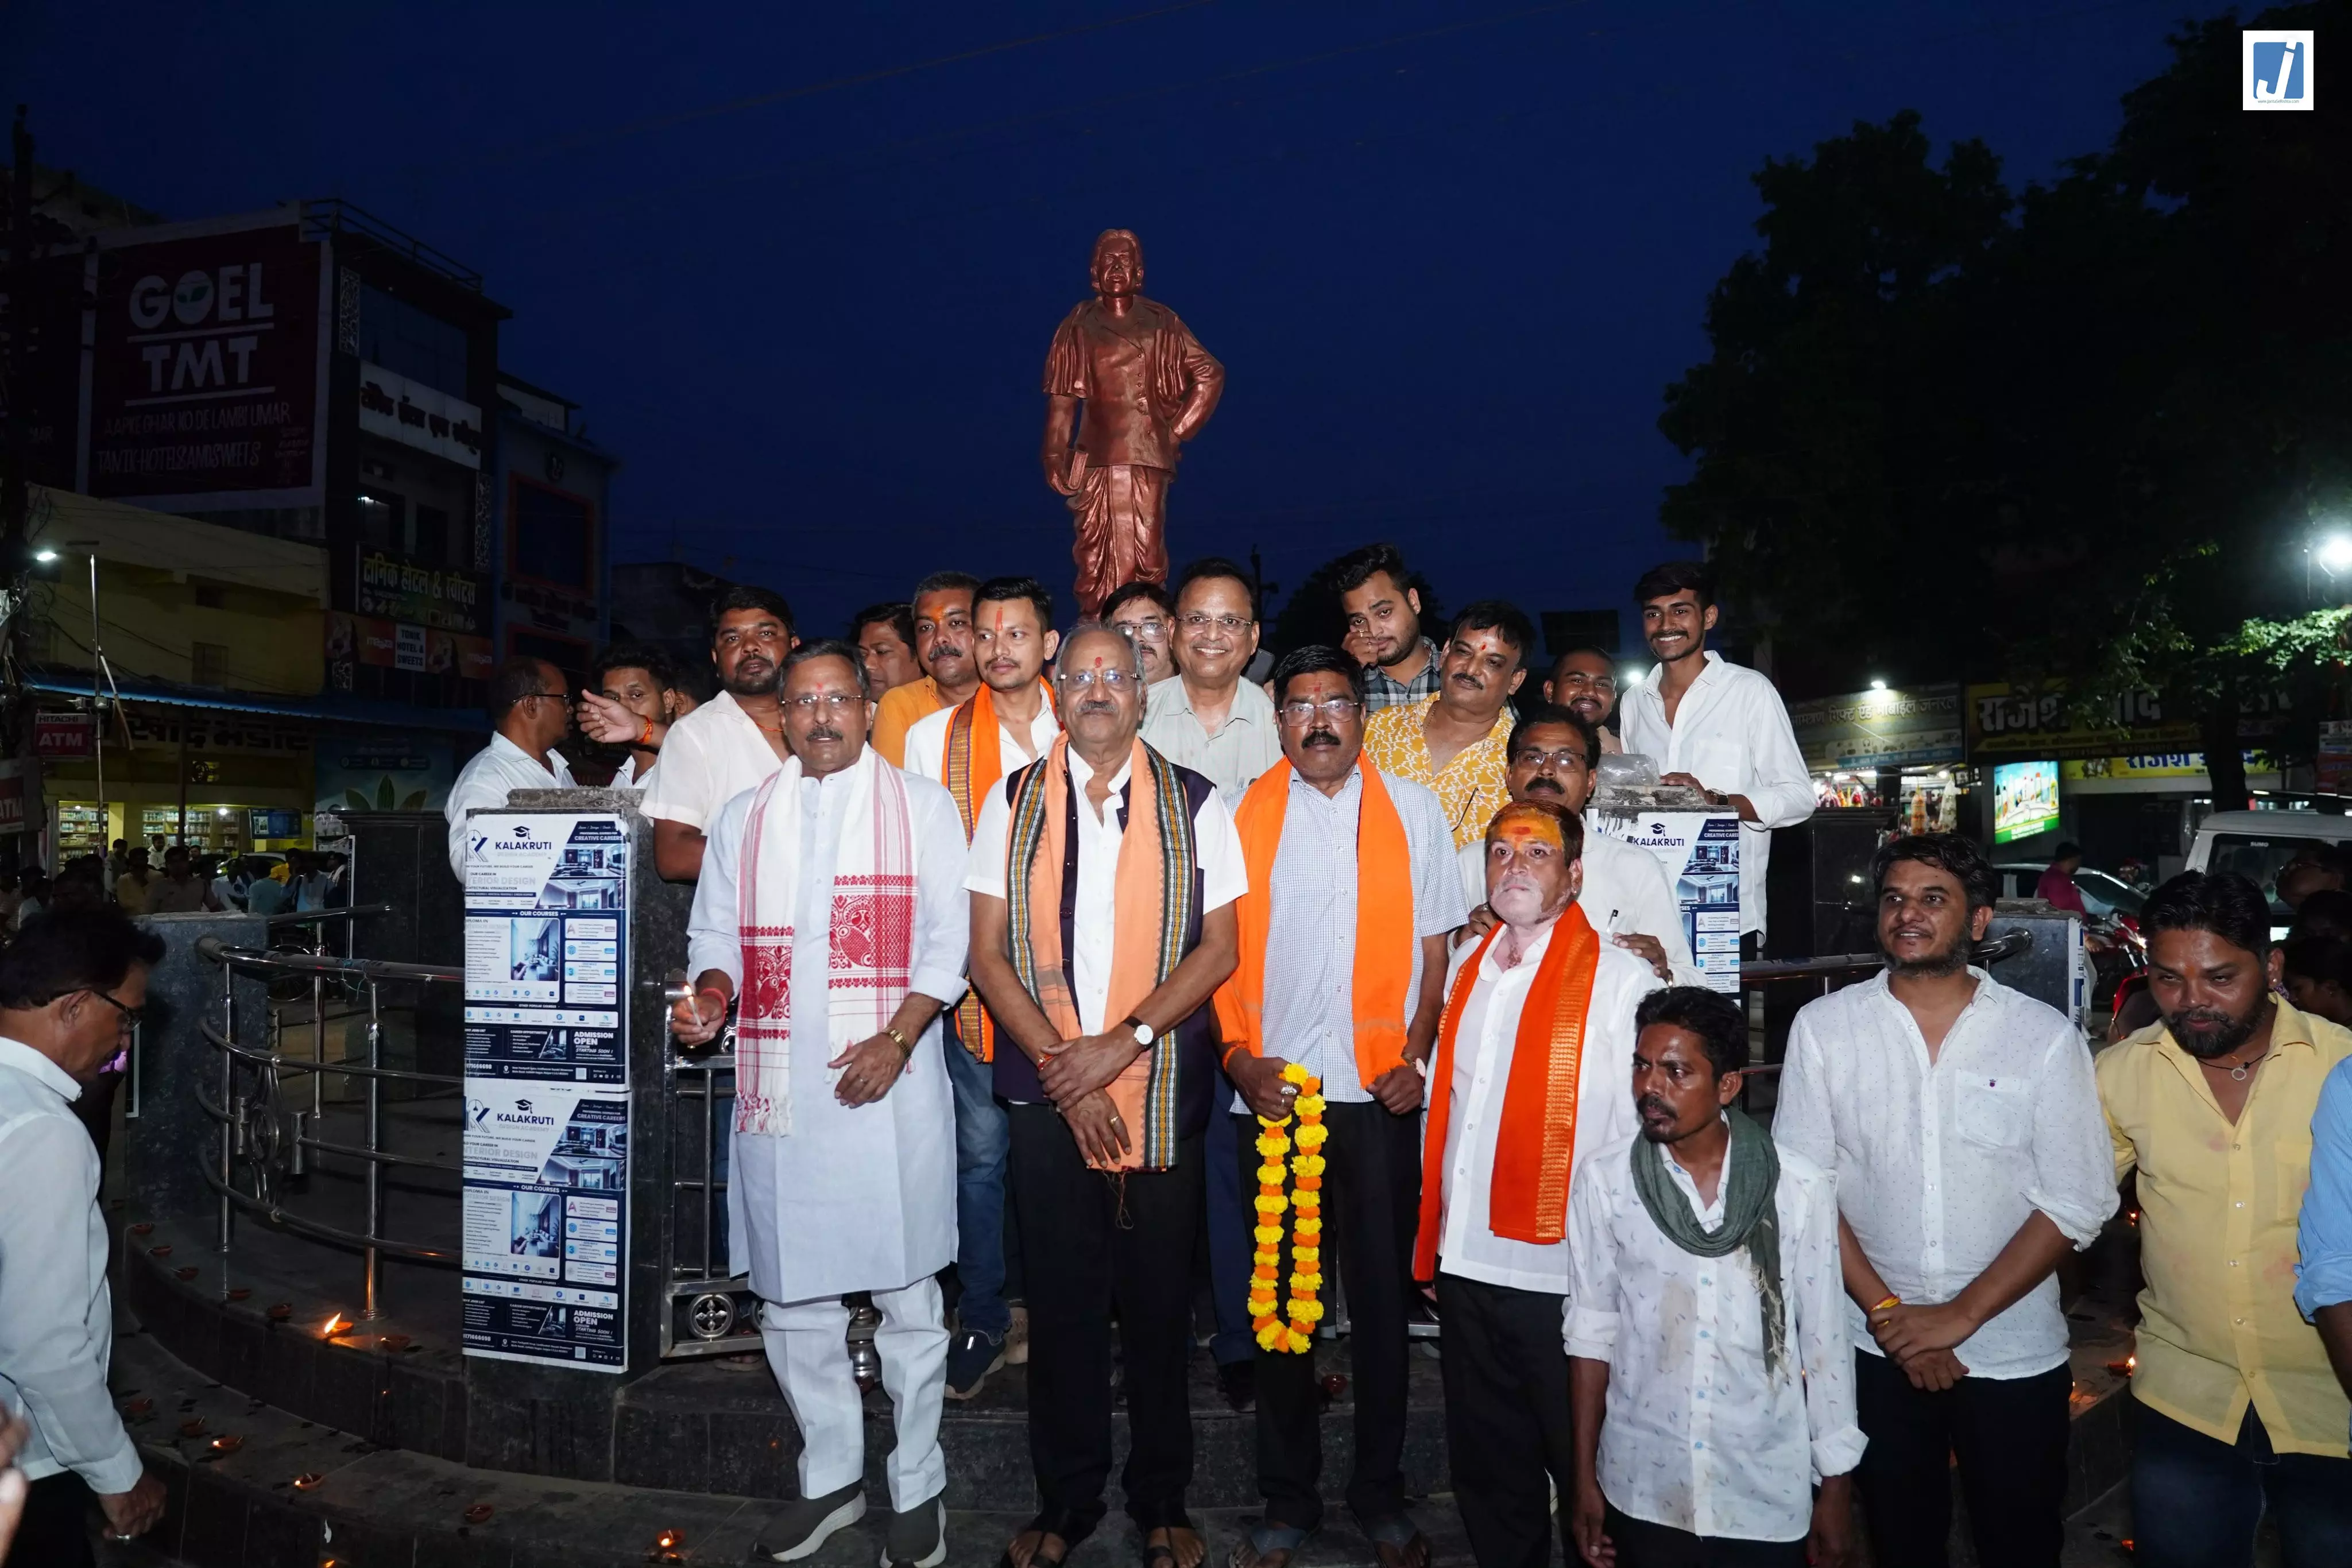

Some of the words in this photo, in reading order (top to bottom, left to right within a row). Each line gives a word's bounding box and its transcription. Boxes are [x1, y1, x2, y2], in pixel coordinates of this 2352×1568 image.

[129, 262, 274, 329] GOEL
[142, 335, 258, 392] TMT
[433, 570, 442, 600] &
[397, 641, 417, 653] HOTEL
[397, 655, 423, 667] SWEETS
[38, 733, 83, 747] ATM
[495, 842, 552, 850] KALAKRUTI
[1634, 838, 1684, 846] KALAKRUTI
[501, 877, 536, 886] DESIGN
[497, 1113, 554, 1125] KALAKRUTI
[464, 1147, 501, 1156] NTERIOR
[503, 1149, 538, 1160] DESIGN
[574, 1310, 613, 1320] ADMISSION
[574, 1316, 598, 1325] OPEN
